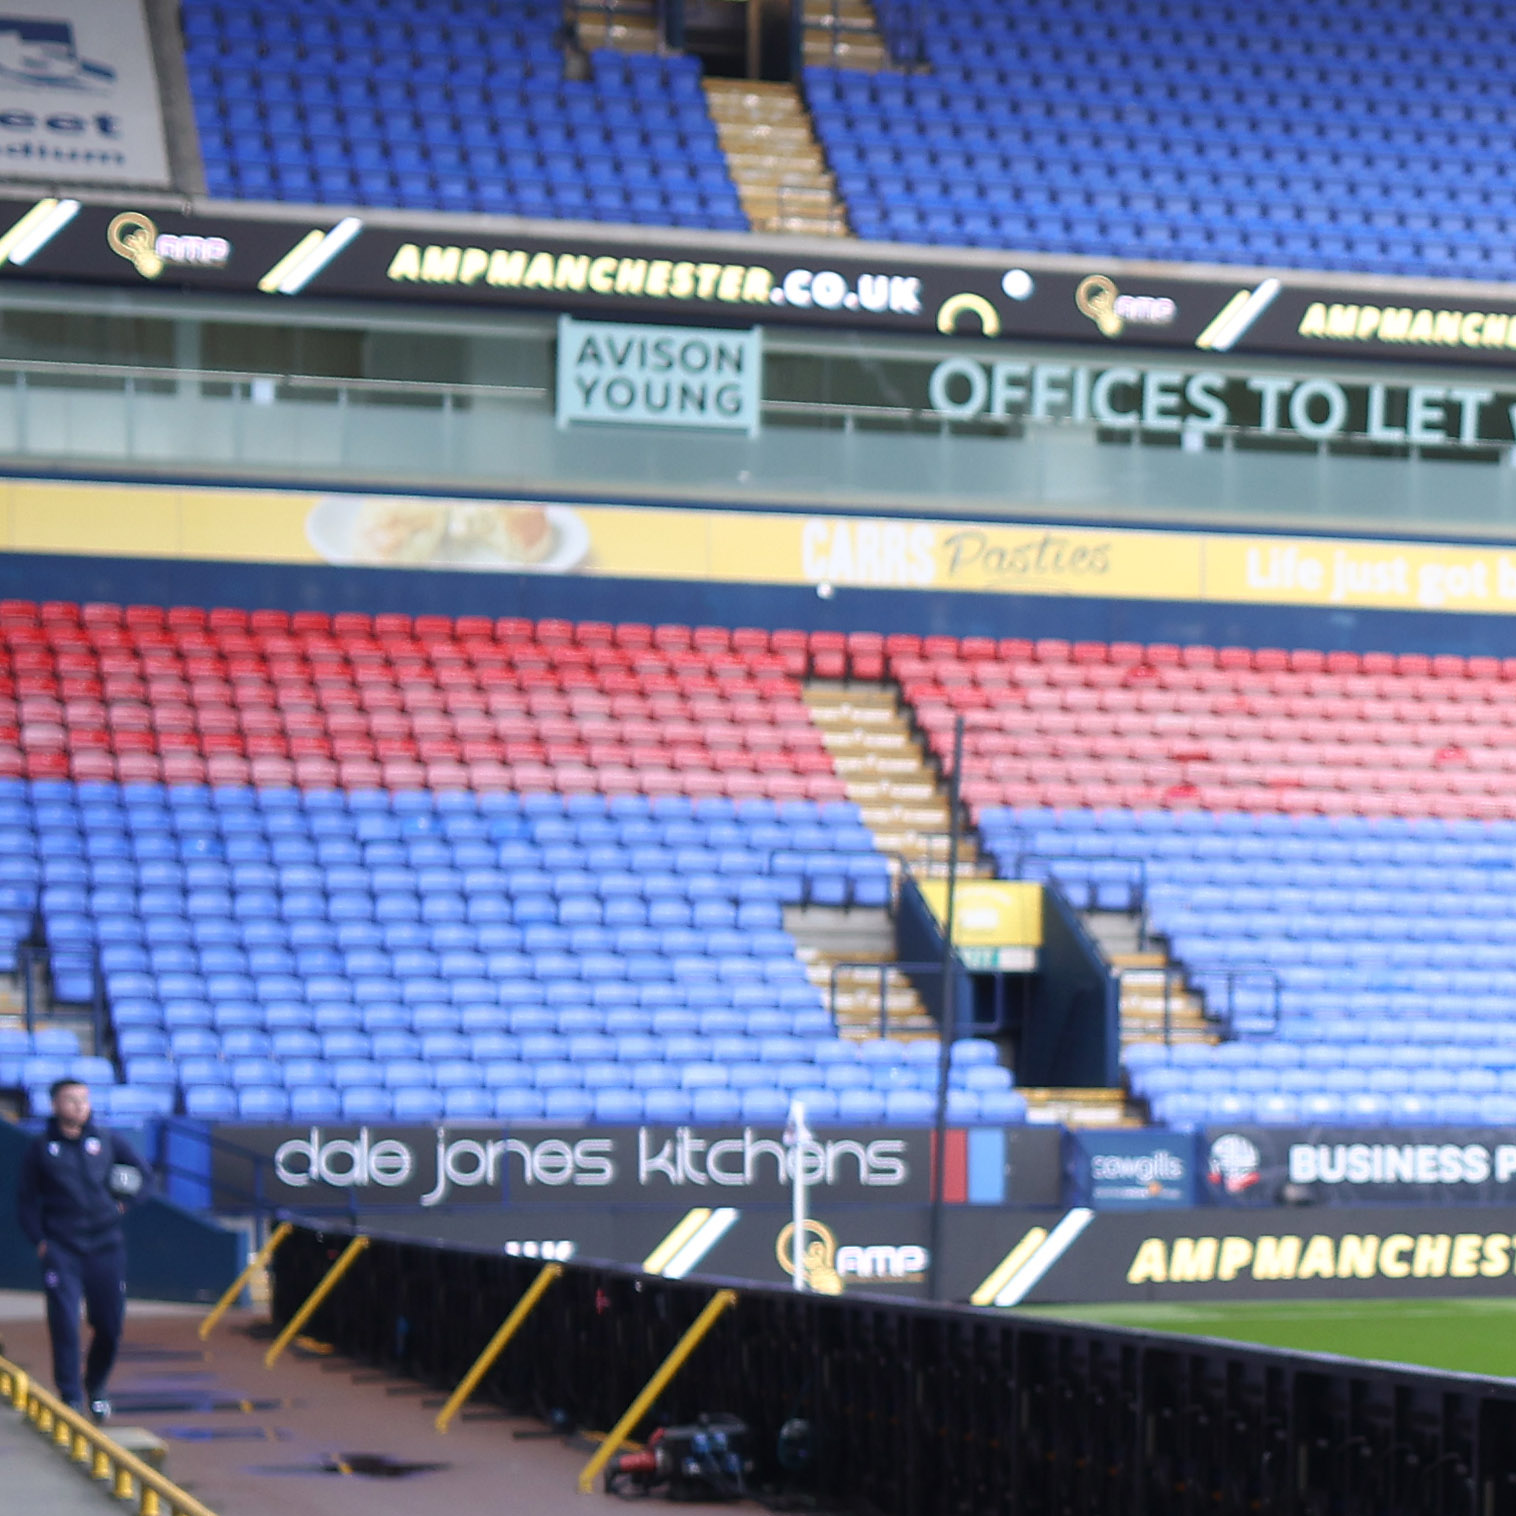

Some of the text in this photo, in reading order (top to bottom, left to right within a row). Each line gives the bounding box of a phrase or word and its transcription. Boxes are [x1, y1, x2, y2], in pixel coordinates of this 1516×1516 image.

[387, 243, 922, 315] AMPMANCHESTER.CO.UK
[576, 335, 744, 374] AVISON
[575, 377, 742, 417] YOUNG
[928, 355, 1230, 432] OFFICES
[1246, 376, 1349, 440] TO
[1365, 382, 1494, 448] LET
[802, 517, 1112, 584] CARRS Pasties
[1246, 547, 1324, 590] Life
[1328, 550, 1411, 601] just
[1417, 561, 1489, 608] got
[275, 1127, 908, 1206] dale jones kitchens
[1288, 1143, 1492, 1184] BUSINESS
